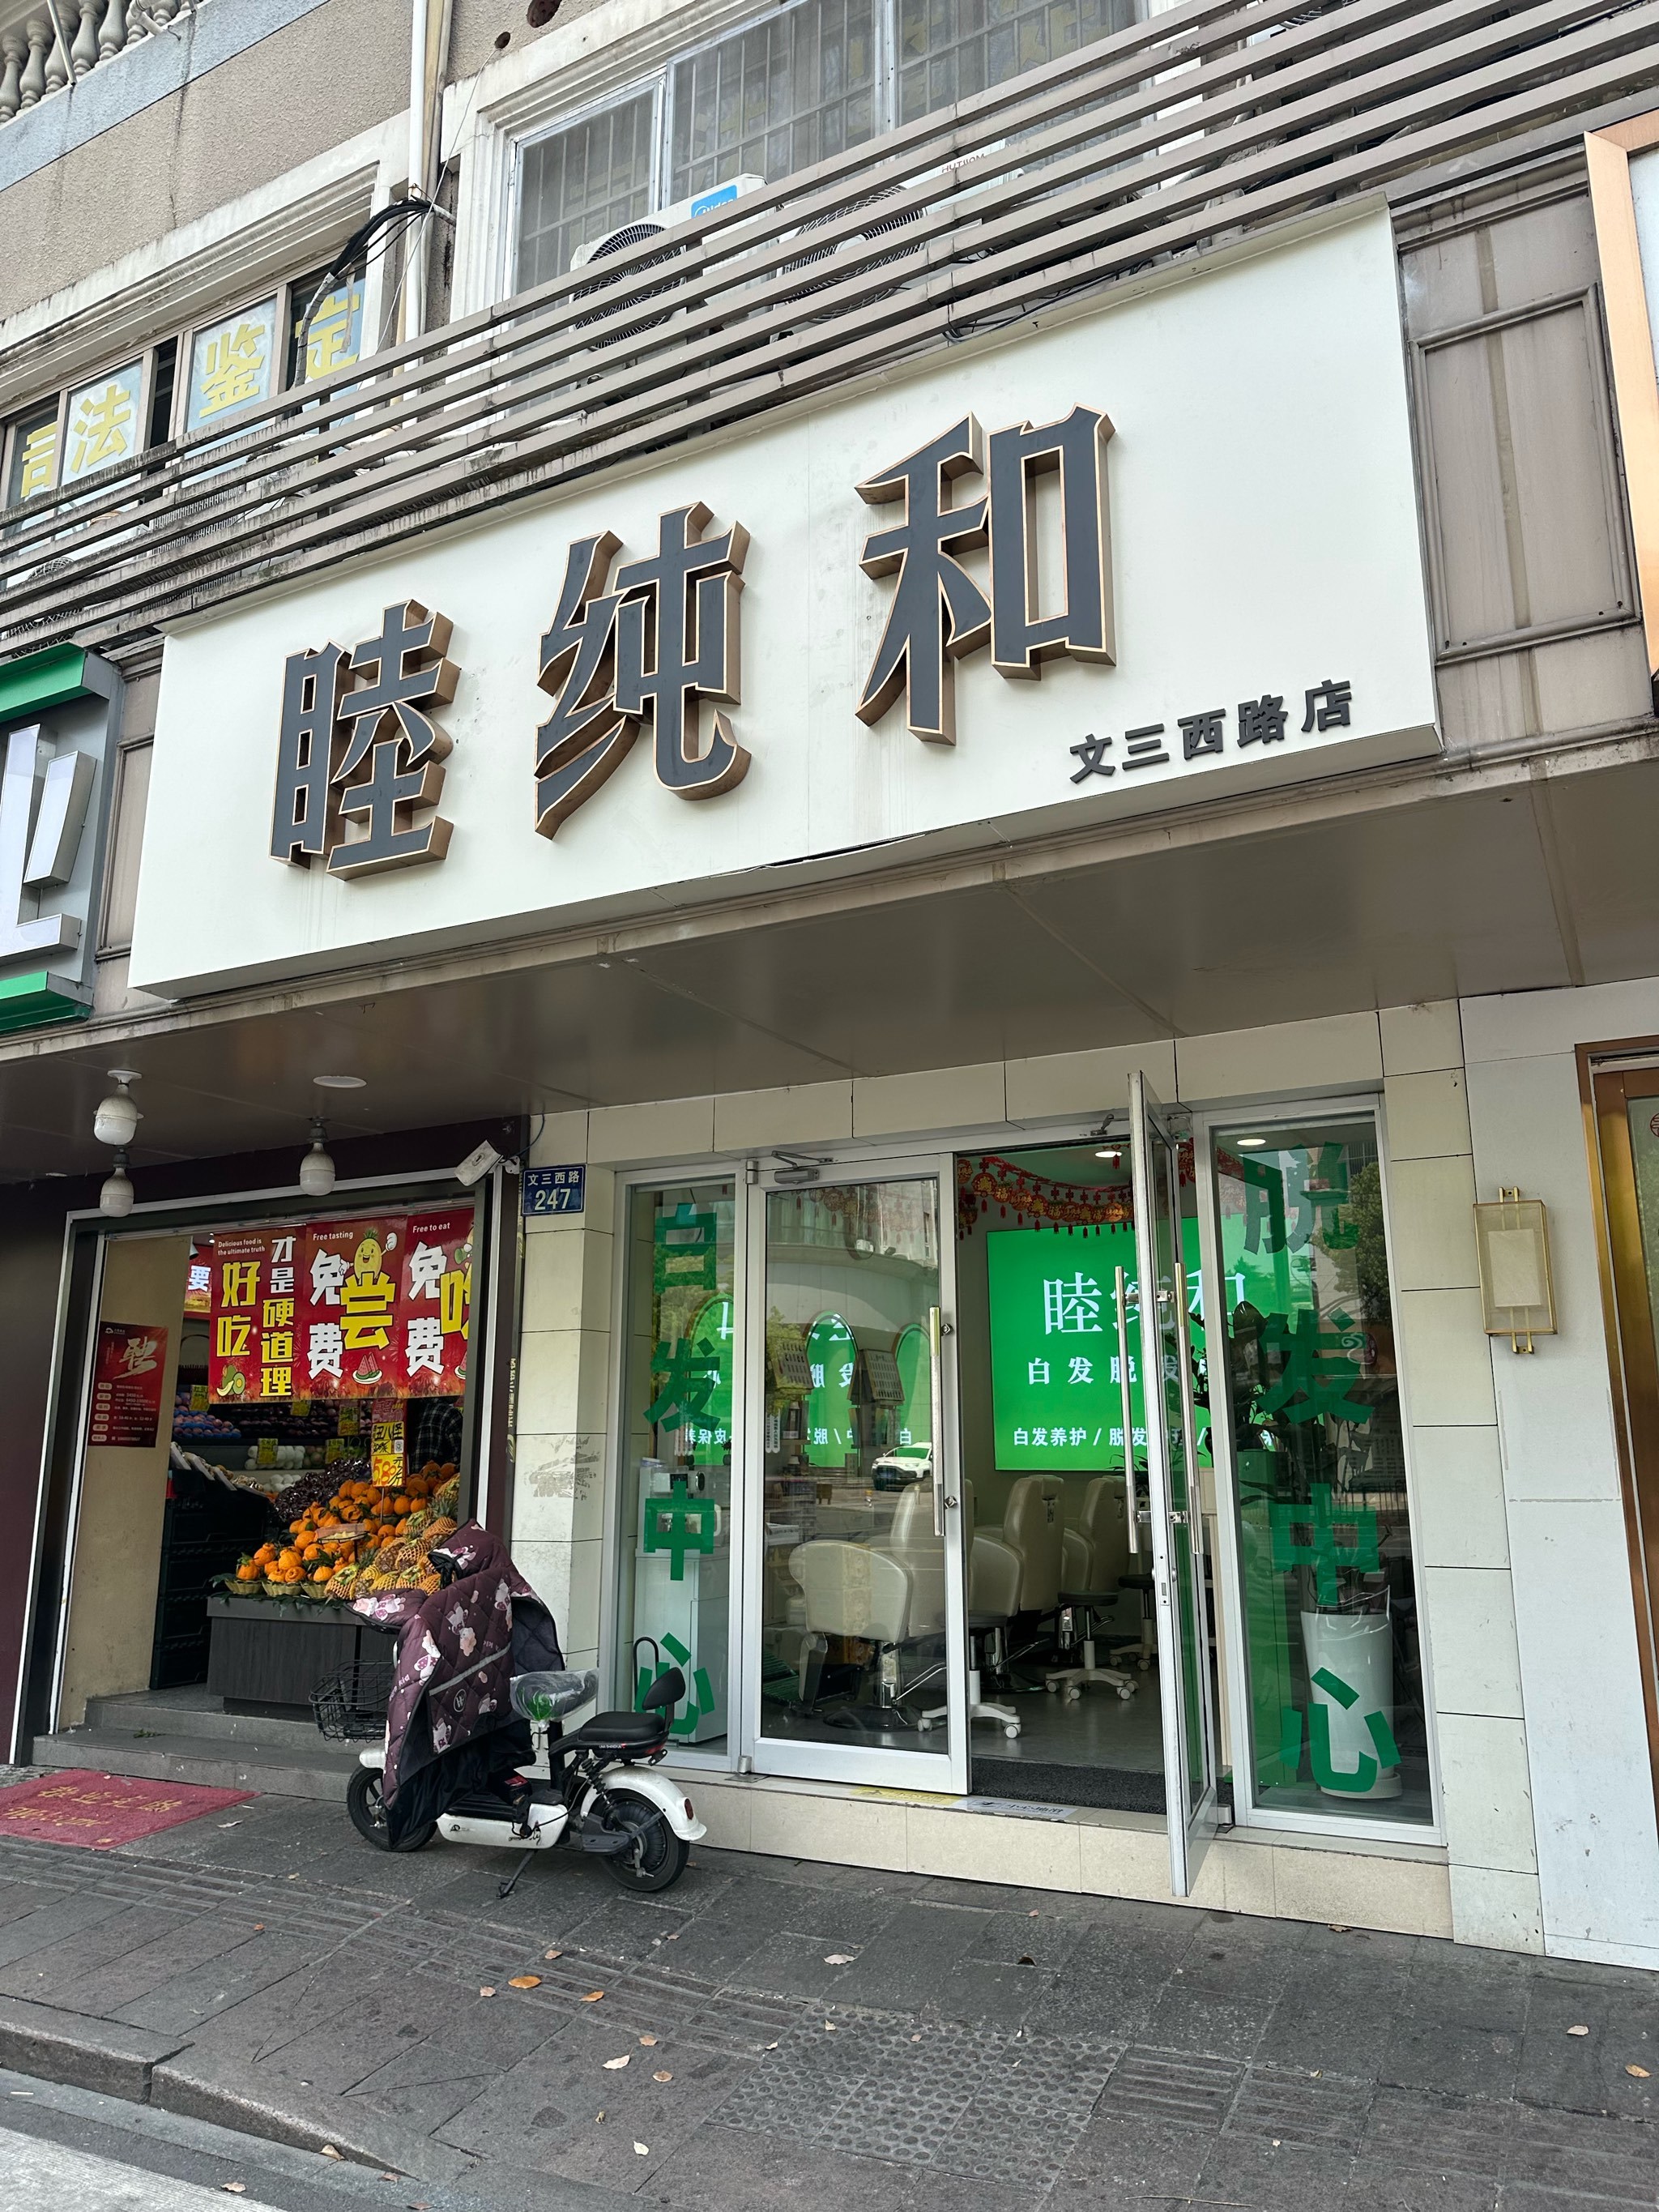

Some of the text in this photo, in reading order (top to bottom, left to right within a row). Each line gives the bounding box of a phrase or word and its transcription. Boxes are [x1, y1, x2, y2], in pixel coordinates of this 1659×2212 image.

[20, 292, 360, 498] 司法鉴定
[270, 403, 1116, 880] 睦纯和
[1070, 679, 1352, 784] 文三西路店
[527, 1170, 580, 1186] 文三西路
[535, 1189, 571, 1211] 247
[218, 1240, 243, 1248] Delicious
[243, 1238, 257, 1246] food
[313, 1231, 354, 1241] Free tasting
[412, 1222, 450, 1233] Free to eat
[228, 1247, 250, 1255] ultimate
[251, 1245, 266, 1253] truth
[188, 1265, 211, 1292] 要
[215, 1260, 262, 1358] 好吃
[260, 1236, 296, 1397] 才是硬道理
[339, 1271, 396, 1351] 尝
[113, 1336, 158, 1380] 聘
[1013, 1427, 1087, 1446] 白发养护
[636, 1202, 720, 1736] 白发中心
[1243, 1141, 1402, 1792] 脱发中心
